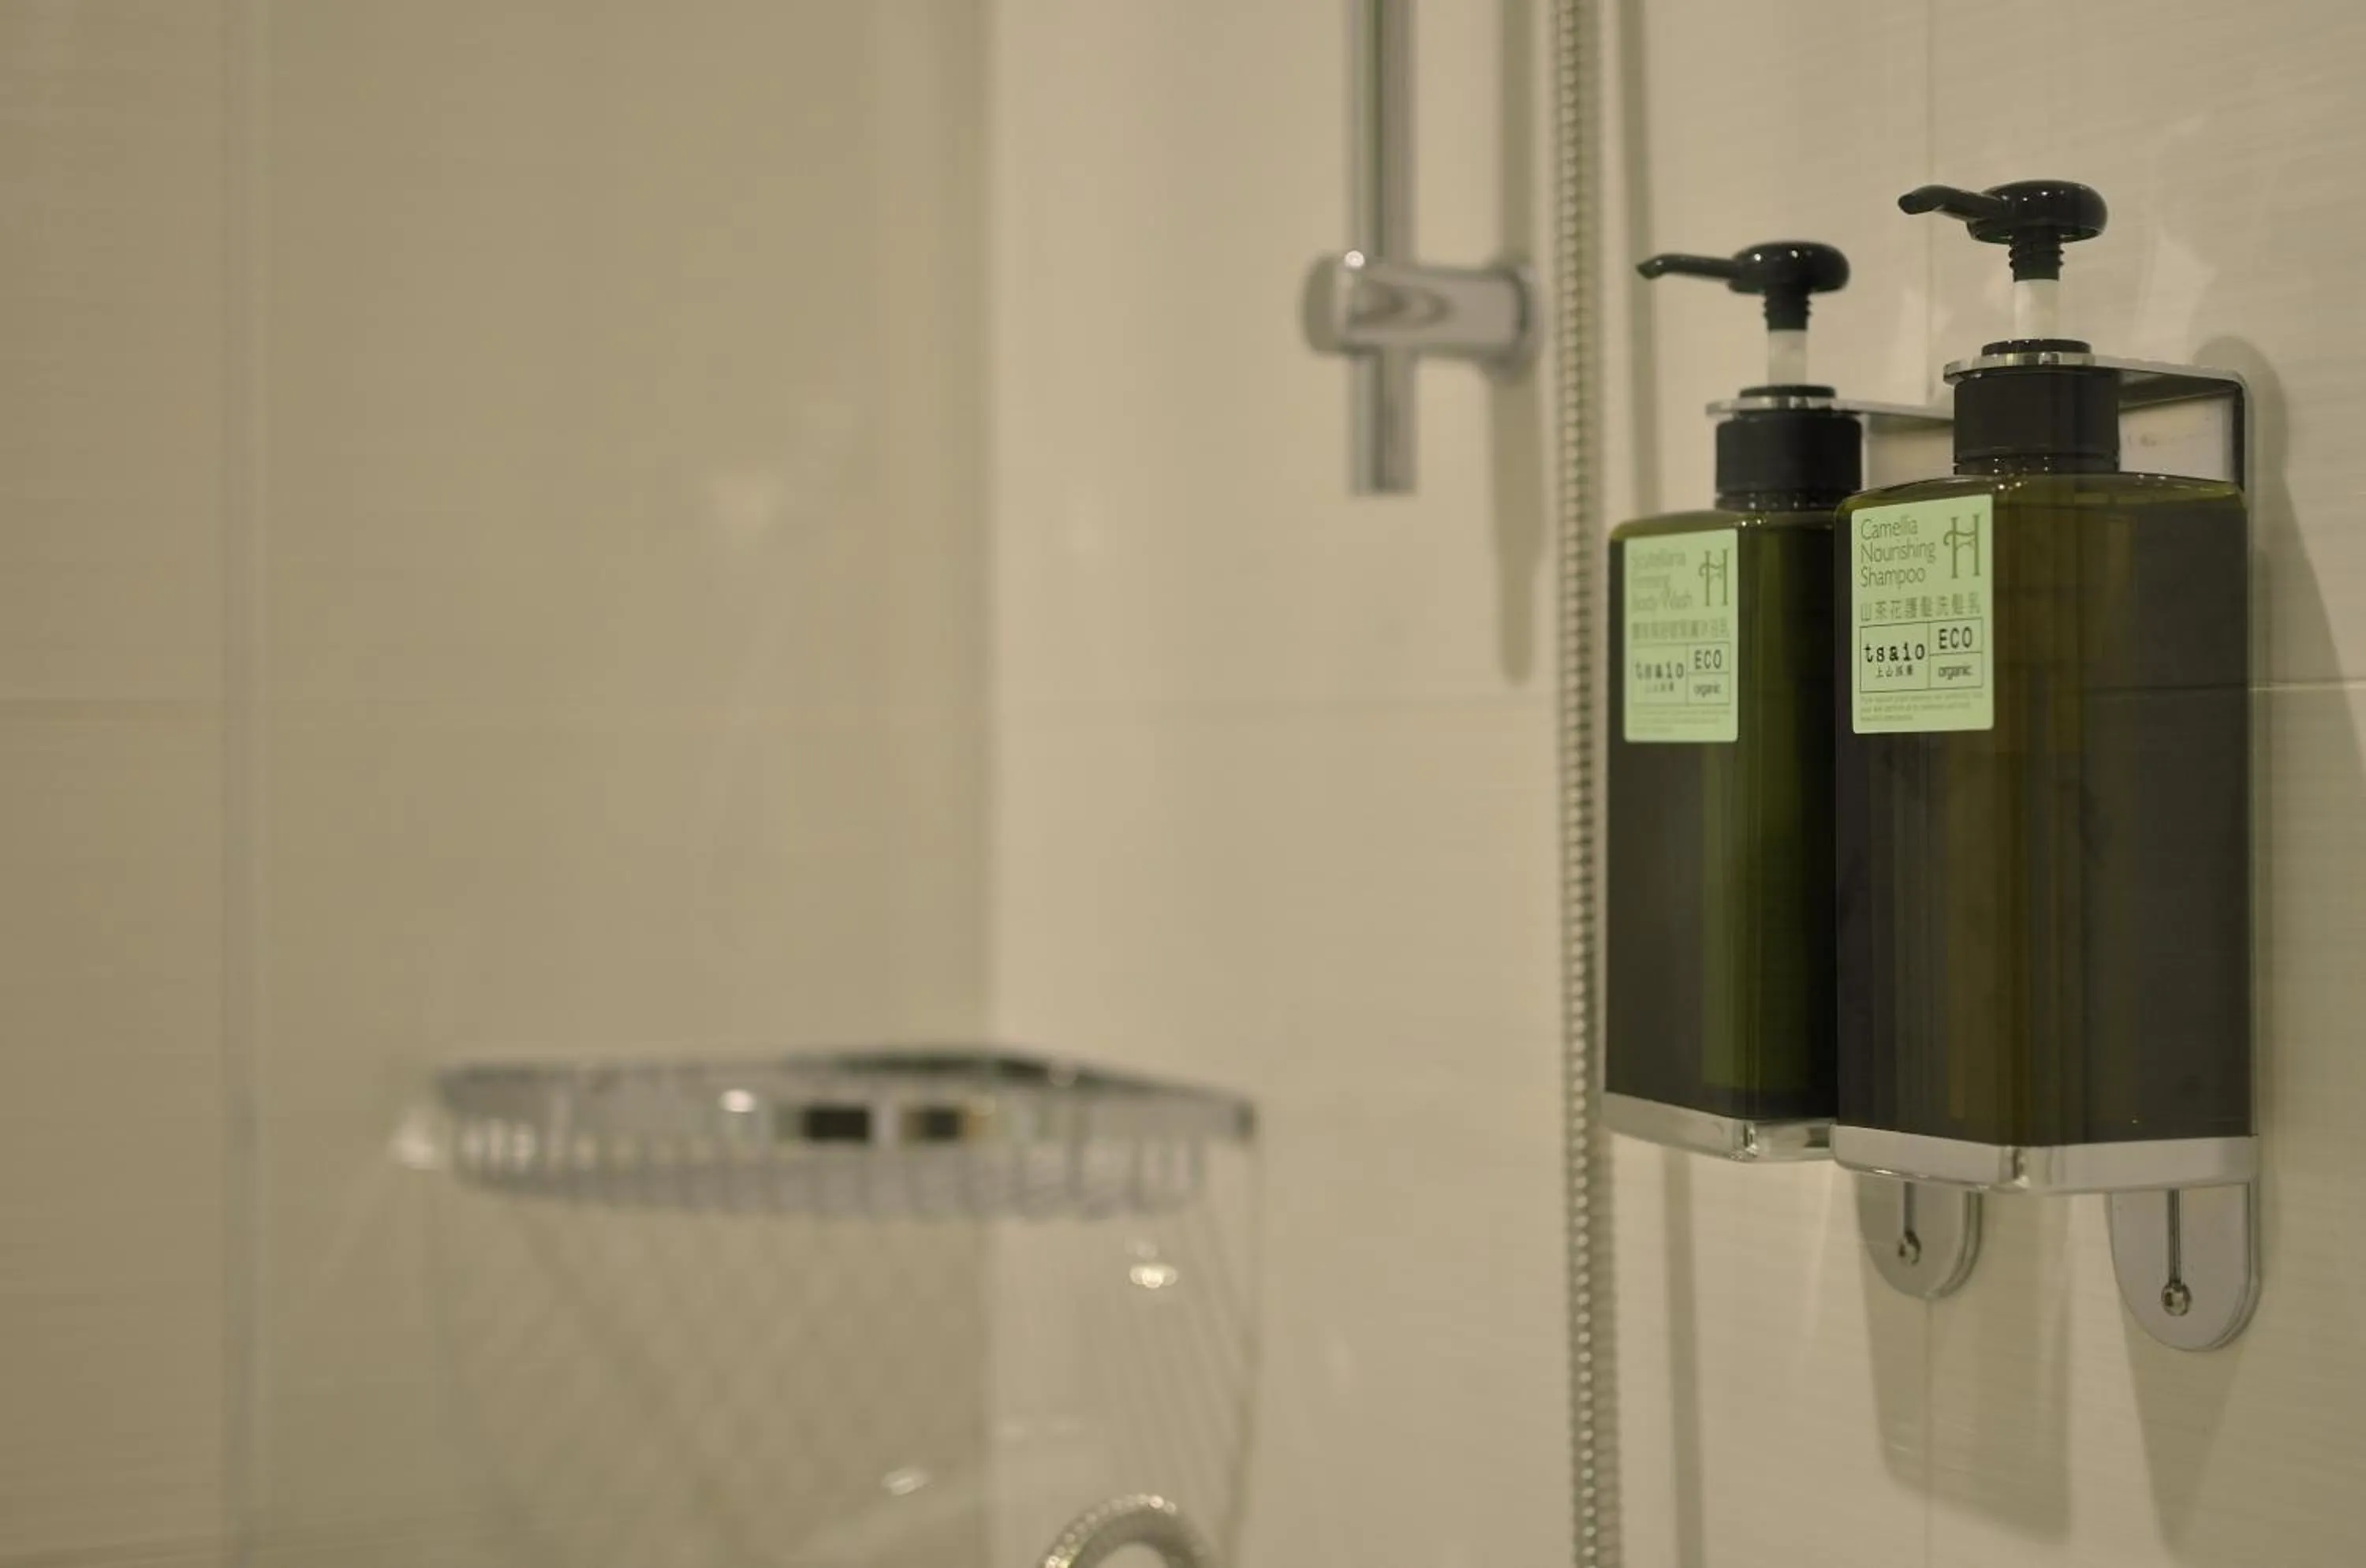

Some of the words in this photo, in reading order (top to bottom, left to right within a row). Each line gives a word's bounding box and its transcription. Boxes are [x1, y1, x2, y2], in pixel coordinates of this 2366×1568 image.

[1860, 538, 1936, 564] Nourishing
[1860, 566, 1926, 590] Shampoo
[1938, 626, 1972, 650] ECO
[1694, 649, 1722, 670] ECO
[1864, 641, 1926, 663] tsaio
